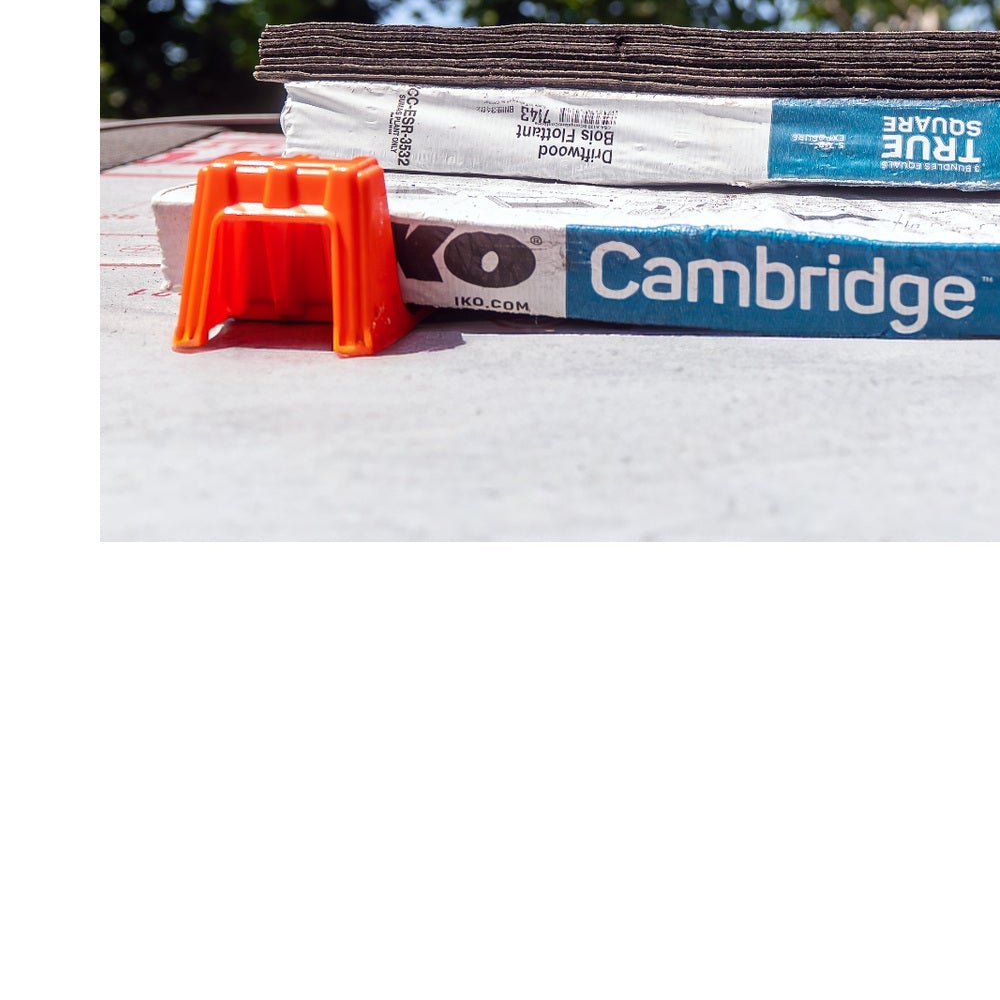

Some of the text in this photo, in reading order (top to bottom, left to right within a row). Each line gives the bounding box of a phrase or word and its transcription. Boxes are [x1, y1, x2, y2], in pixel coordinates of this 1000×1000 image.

[520, 105, 551, 124] 7143
[392, 116, 401, 137] PLANT
[516, 124, 614, 146] Bois Flottant
[883, 115, 982, 137] SQUARE
[390, 137, 399, 154] ONLY
[538, 145, 613, 164] Driftwood
[881, 134, 982, 163] TRUE
[924, 162, 972, 173] BUNDLES
[392, 221, 536, 289] KO
[589, 240, 976, 334] Cambridge
[454, 296, 529, 312] IKO.COM
